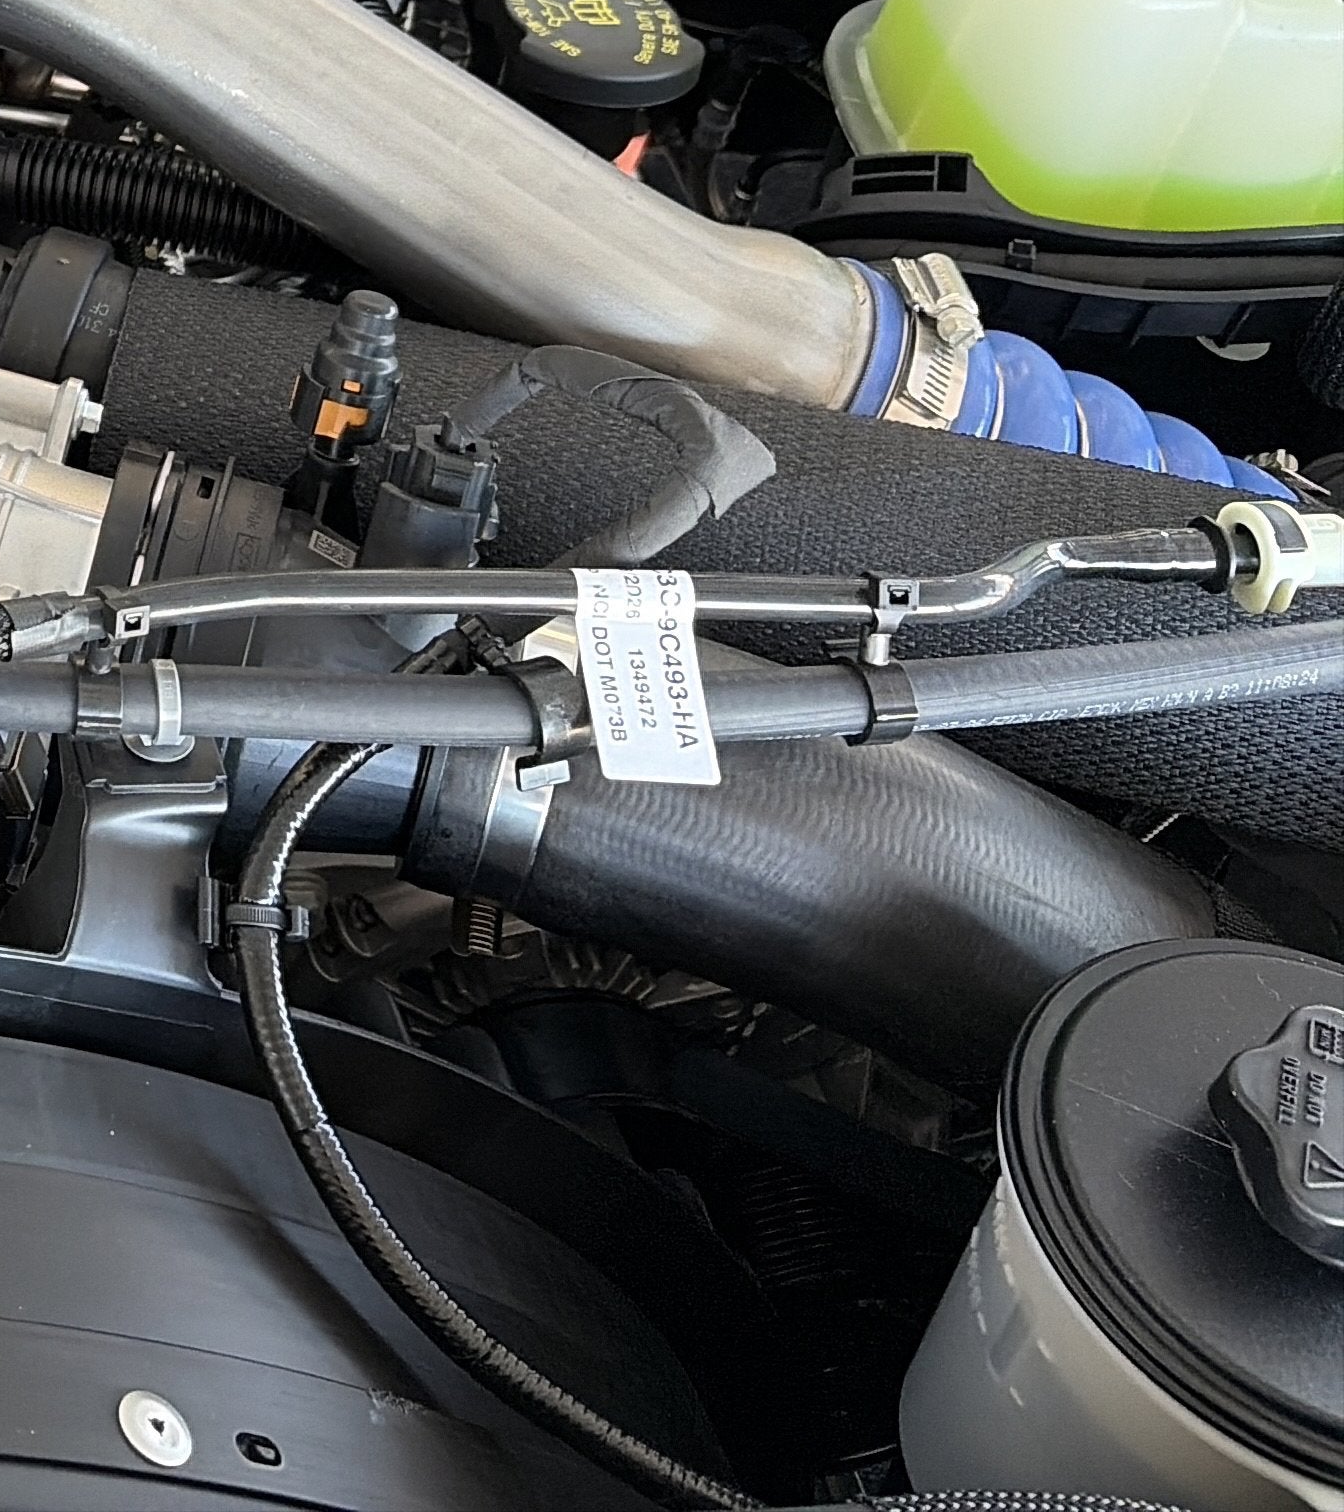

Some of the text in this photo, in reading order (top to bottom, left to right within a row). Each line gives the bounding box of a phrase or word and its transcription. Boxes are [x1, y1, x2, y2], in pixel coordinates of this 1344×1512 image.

[591, 626, 614, 670] DOT
[598, 674, 629, 742] M073B
[627, 647, 658, 730] 1349472
[1276, 1055, 1302, 1127] OVERFILL
